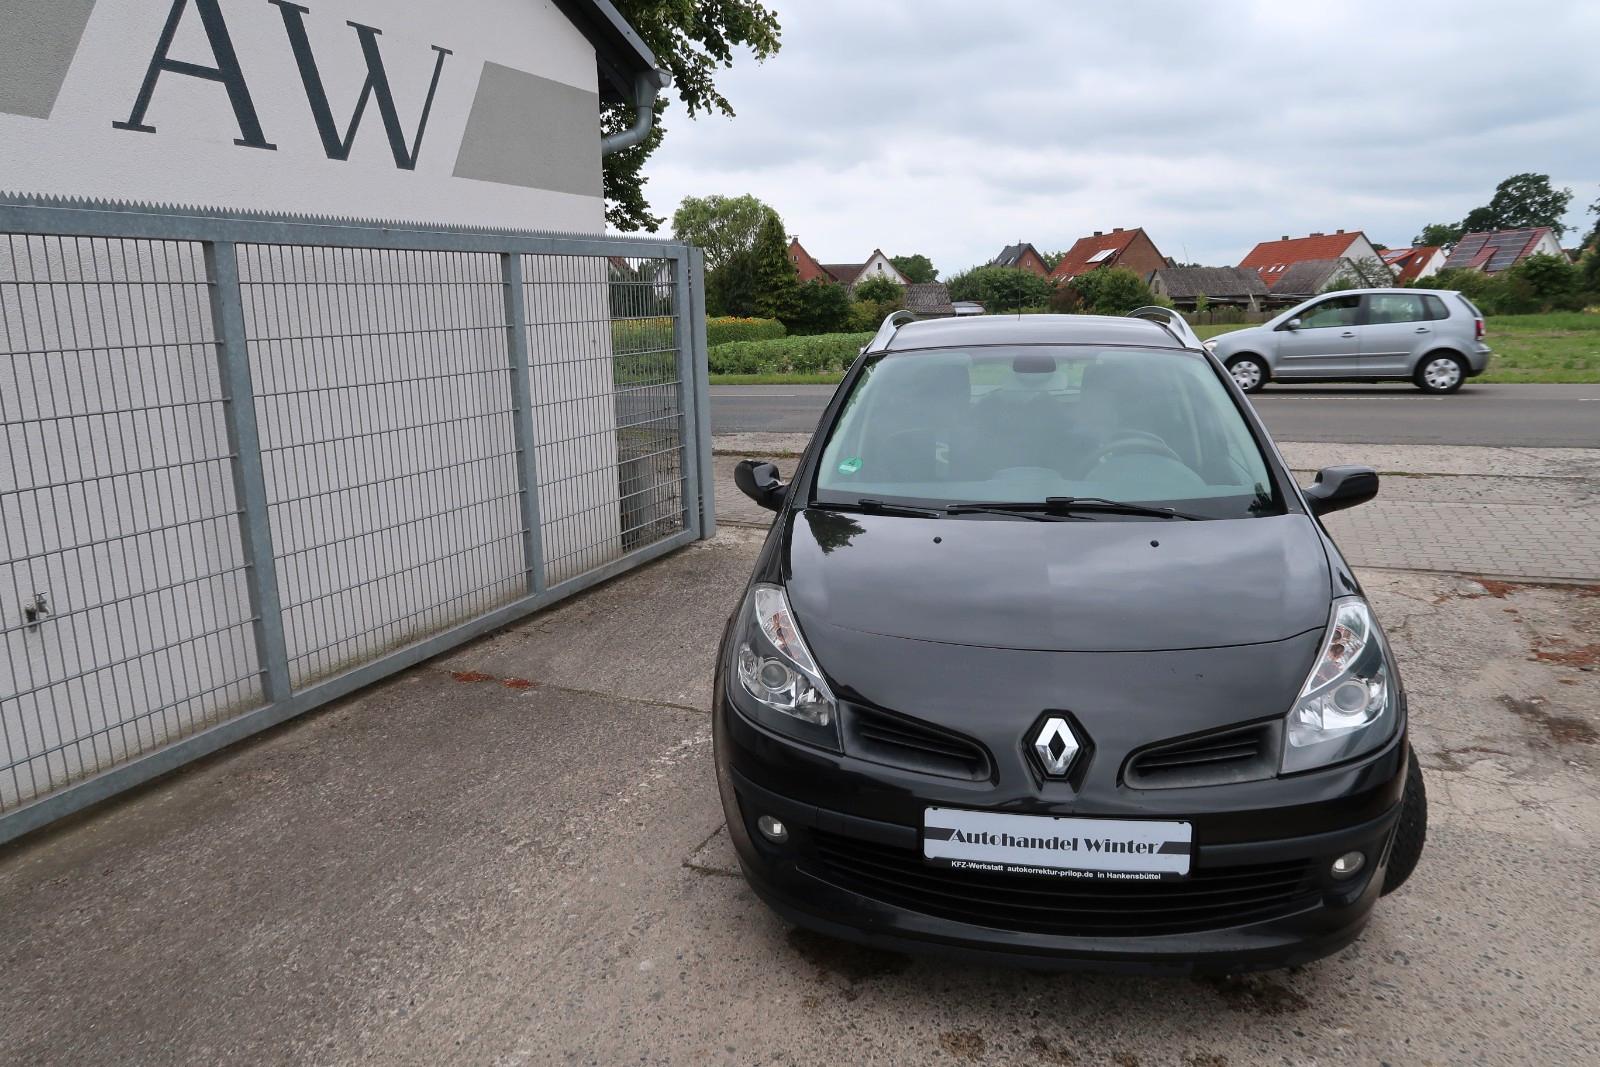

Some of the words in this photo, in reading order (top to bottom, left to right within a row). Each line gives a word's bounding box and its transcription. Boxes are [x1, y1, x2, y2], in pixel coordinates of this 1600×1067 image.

[112, 0, 453, 171] AW
[951, 828, 1079, 852] Autohandel
[1083, 838, 1159, 855] Winter
[951, 860, 1004, 872] KFZ-Werkstatt
[1007, 865, 1094, 878] autokorrektur-prilop.de
[1106, 872, 1161, 880] Hankensbüttel
